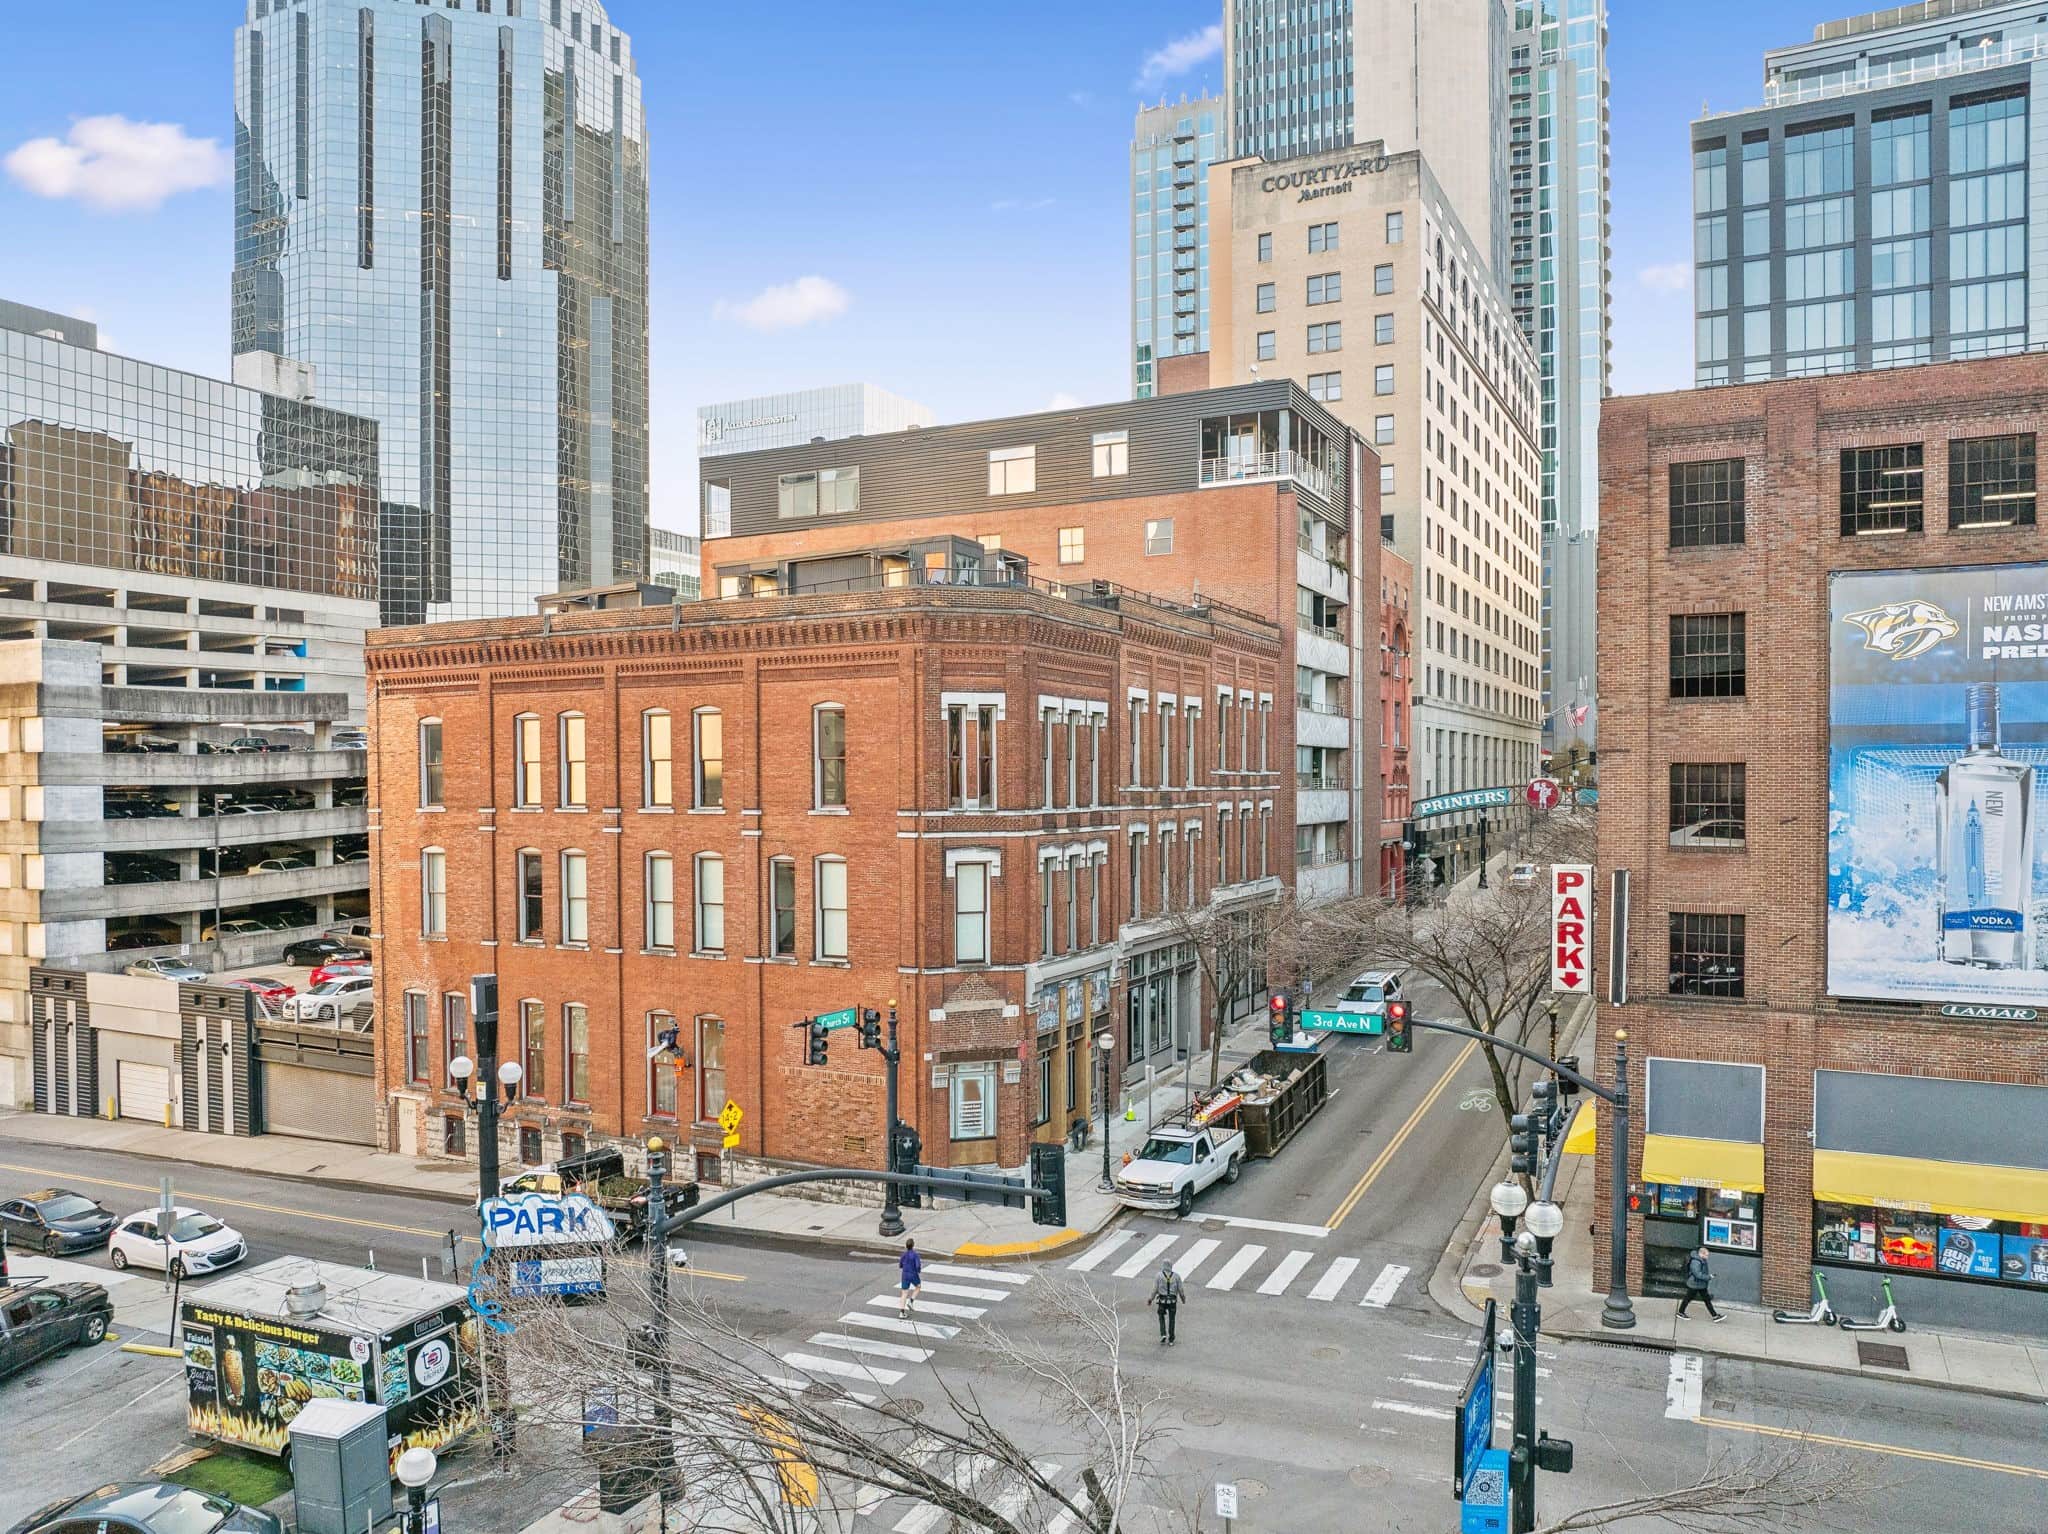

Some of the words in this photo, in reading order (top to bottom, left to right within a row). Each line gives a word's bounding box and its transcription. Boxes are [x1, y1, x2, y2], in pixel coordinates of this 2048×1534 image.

[1261, 155, 1389, 193] COURTYARD
[1297, 180, 1352, 203] Marriott
[1983, 595, 2013, 612] NEW
[2003, 614, 2037, 622] PROUD
[1420, 789, 1507, 817] PRINTERS
[1985, 790, 2004, 817] NEW
[1556, 871, 1585, 970] PARK
[1971, 915, 2013, 925] VODKA
[1312, 1014, 1333, 1028] 3rd
[1335, 1016, 1358, 1029] Ave
[1359, 1016, 1371, 1030] N
[1949, 1006, 2028, 1019] LAMAR
[489, 1206, 591, 1235] PARK
[1943, 1248, 1971, 1265] BUD
[194, 1308, 223, 1326] Tasty
[224, 1315, 234, 1326] &
[234, 1316, 284, 1337] Delicious
[284, 1326, 320, 1345] Burger
